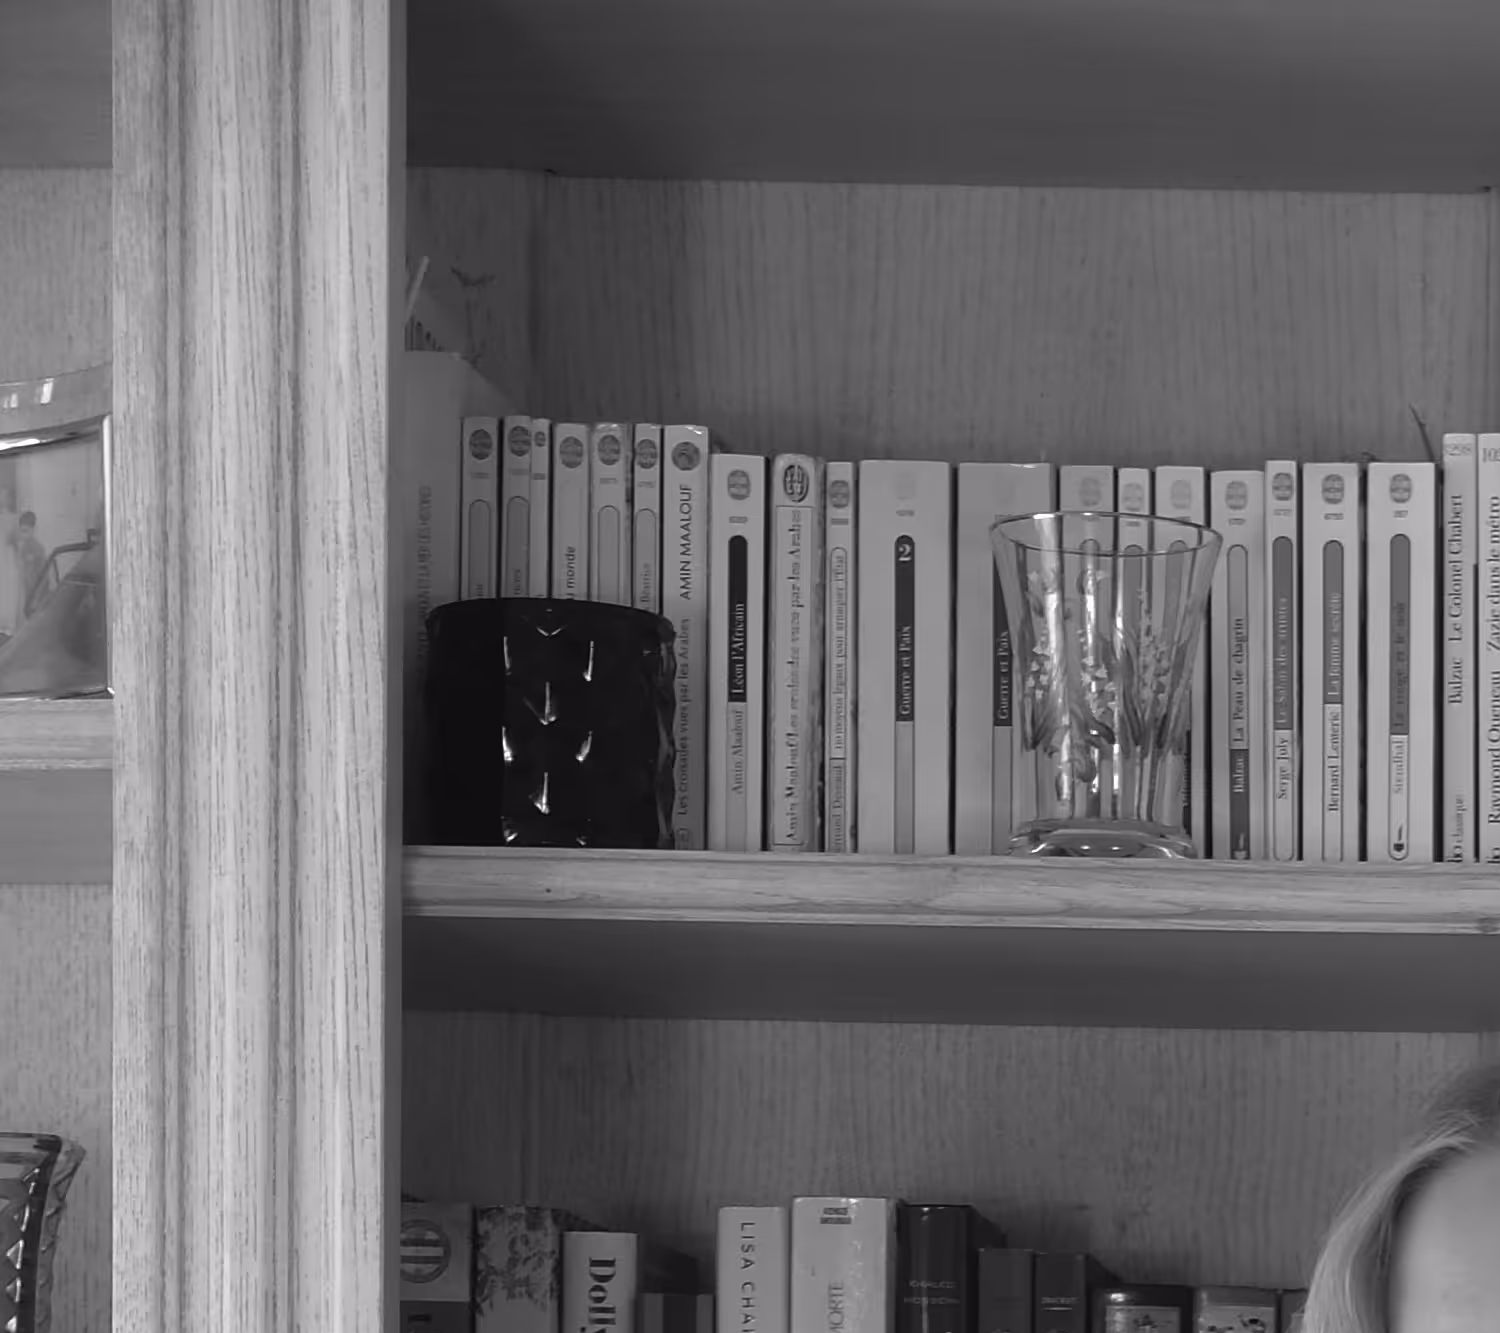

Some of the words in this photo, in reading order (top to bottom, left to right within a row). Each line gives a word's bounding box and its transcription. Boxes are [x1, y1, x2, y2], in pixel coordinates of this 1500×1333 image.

[679, 484, 692, 557] MAALOUF
[1447, 494, 1463, 556] Chabert
[899, 544, 912, 562] 2
[679, 561, 692, 601] AMIN
[1447, 559, 1463, 619] Colonel
[676, 617, 690, 660] Arabes
[731, 602, 745, 660] l'Africain
[898, 625, 911, 652] Paix
[997, 630, 1009, 657] Paix
[1231, 617, 1247, 665] chagrin
[1447, 622, 1463, 641] Le
[676, 662, 690, 680] les
[731, 663, 745, 694] Léon
[898, 654, 911, 668] et
[997, 661, 1009, 673] et
[1231, 670, 1244, 685] de
[677, 682, 694, 702] par
[898, 670, 911, 715] Guerre
[1447, 656, 1463, 704] Balzac
[997, 679, 1009, 720] Guerre
[1231, 691, 1244, 720] Peau
[732, 709, 745, 756] Maalouf
[1231, 727, 1244, 742] La
[732, 759, 745, 795] Amin
[1276, 766, 1289, 800] Serge
[1328, 766, 1339, 812] Bernard
[677, 795, 690, 816] Les
[786, 801, 798, 841] Amin
[740, 1221, 756, 1270] LISA
